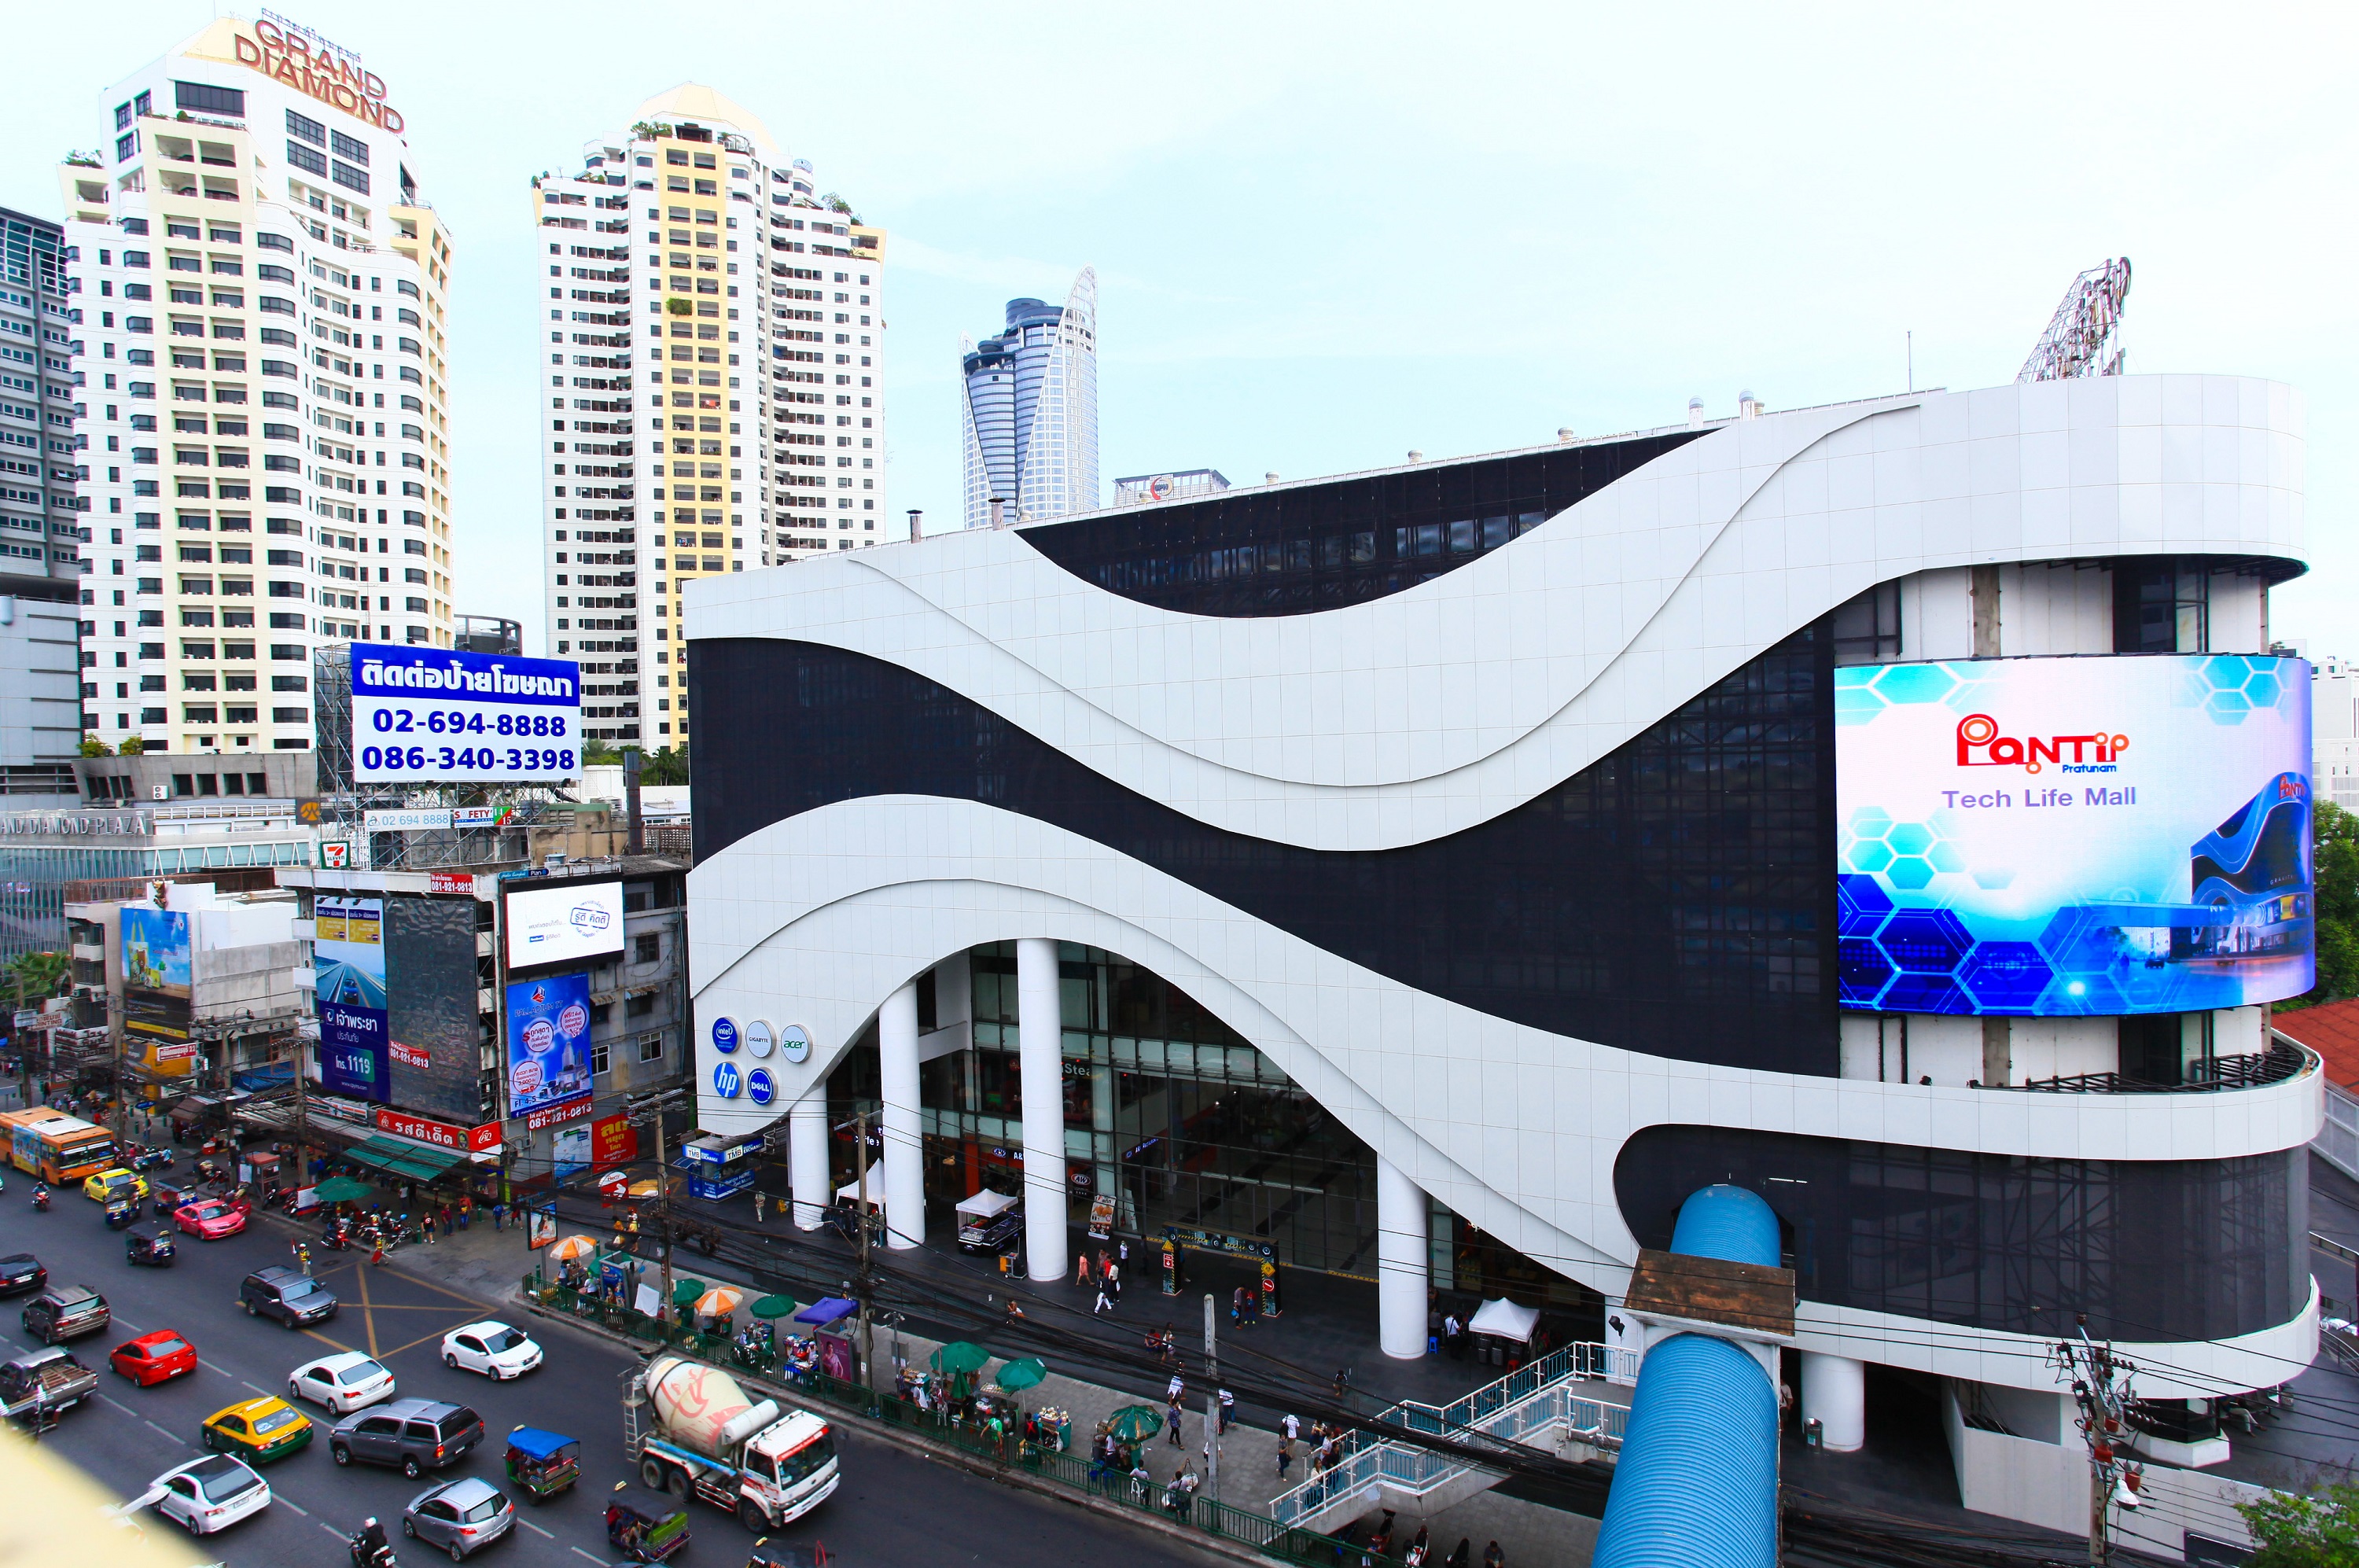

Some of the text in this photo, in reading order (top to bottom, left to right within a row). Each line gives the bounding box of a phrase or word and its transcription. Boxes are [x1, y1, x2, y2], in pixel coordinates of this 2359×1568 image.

[255, 20, 387, 101] GRAND
[234, 33, 405, 134] DIAMOND
[362, 658, 573, 698] ติดต่อป้ายโฆษณา
[372, 709, 567, 738] 02-694-8888
[362, 745, 576, 771] 086-340-3398
[2062, 764, 2117, 774] Pratunam
[1941, 786, 2136, 808] Tech Life Mall
[382, 814, 449, 826] 02 694 8888
[495, 808, 503, 816] 14
[502, 815, 511, 825] 15
[30, 816, 90, 835] DIAMOND
[96, 815, 147, 835] PLAZA
[327, 846, 344, 866] 7
[431, 881, 473, 893] 081-921-0813
[336, 1008, 377, 1032] เจ้าพระยา
[514, 1003, 554, 1018] PALLADIUM
[337, 1030, 359, 1043] ประกันภัย
[783, 1040, 805, 1049] acer
[336, 1055, 370, 1074] โทร. 1119
[717, 1063, 738, 1098] hp
[751, 1081, 770, 1092] DELL
[395, 1122, 454, 1145] รสดีเด็ด
[688, 1149, 700, 1158] TMB
[727, 1148, 742, 1160] TMB
